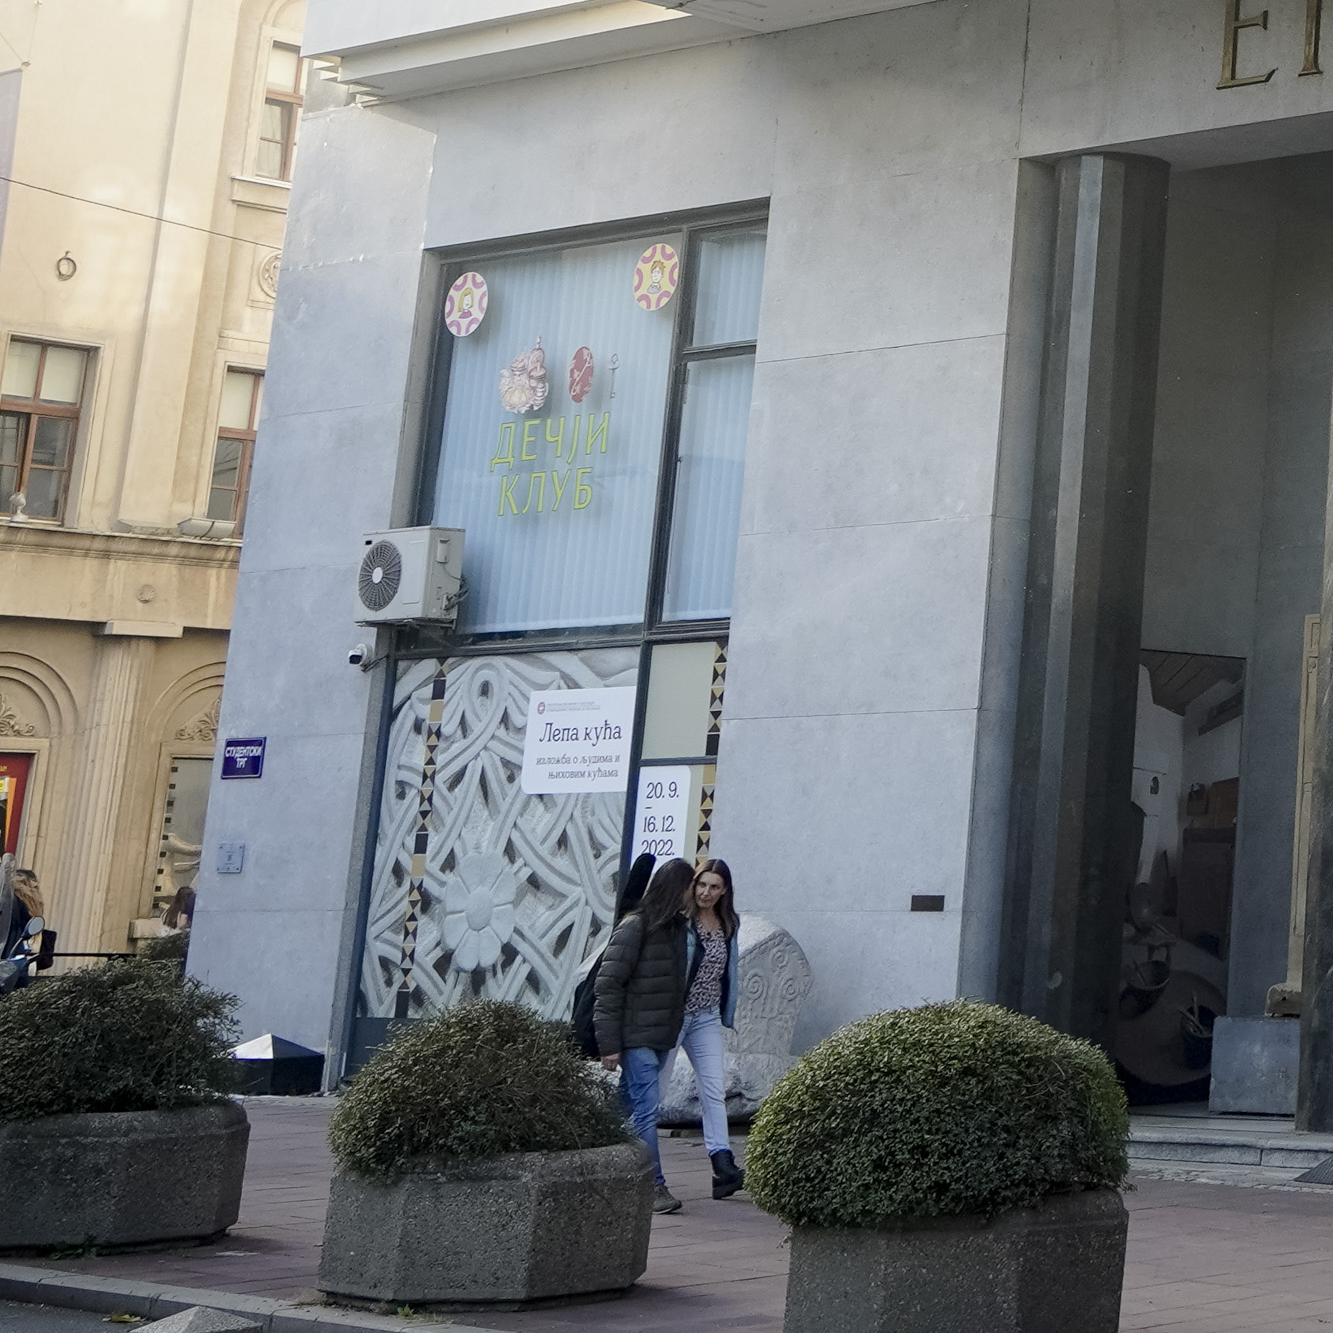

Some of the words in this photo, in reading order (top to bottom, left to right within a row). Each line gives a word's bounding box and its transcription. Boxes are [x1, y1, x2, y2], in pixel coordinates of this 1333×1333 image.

[490, 412, 610, 472] ДЕЧЈИ
[498, 467, 593, 516] КЛУБ
[539, 722, 579, 743] Лепа
[583, 719, 622, 747] кућа
[225, 746, 262, 759] СТУДЕНТСКИ
[615, 755, 620, 763] и
[236, 757, 247, 768] ТРГ
[587, 767, 619, 781] кућама
[646, 782, 665, 798] 20.
[668, 781, 679, 798] 9.
[643, 816, 658, 832] 16.
[661, 815, 676, 832] 12.
[641, 839, 675, 856] 2022.
